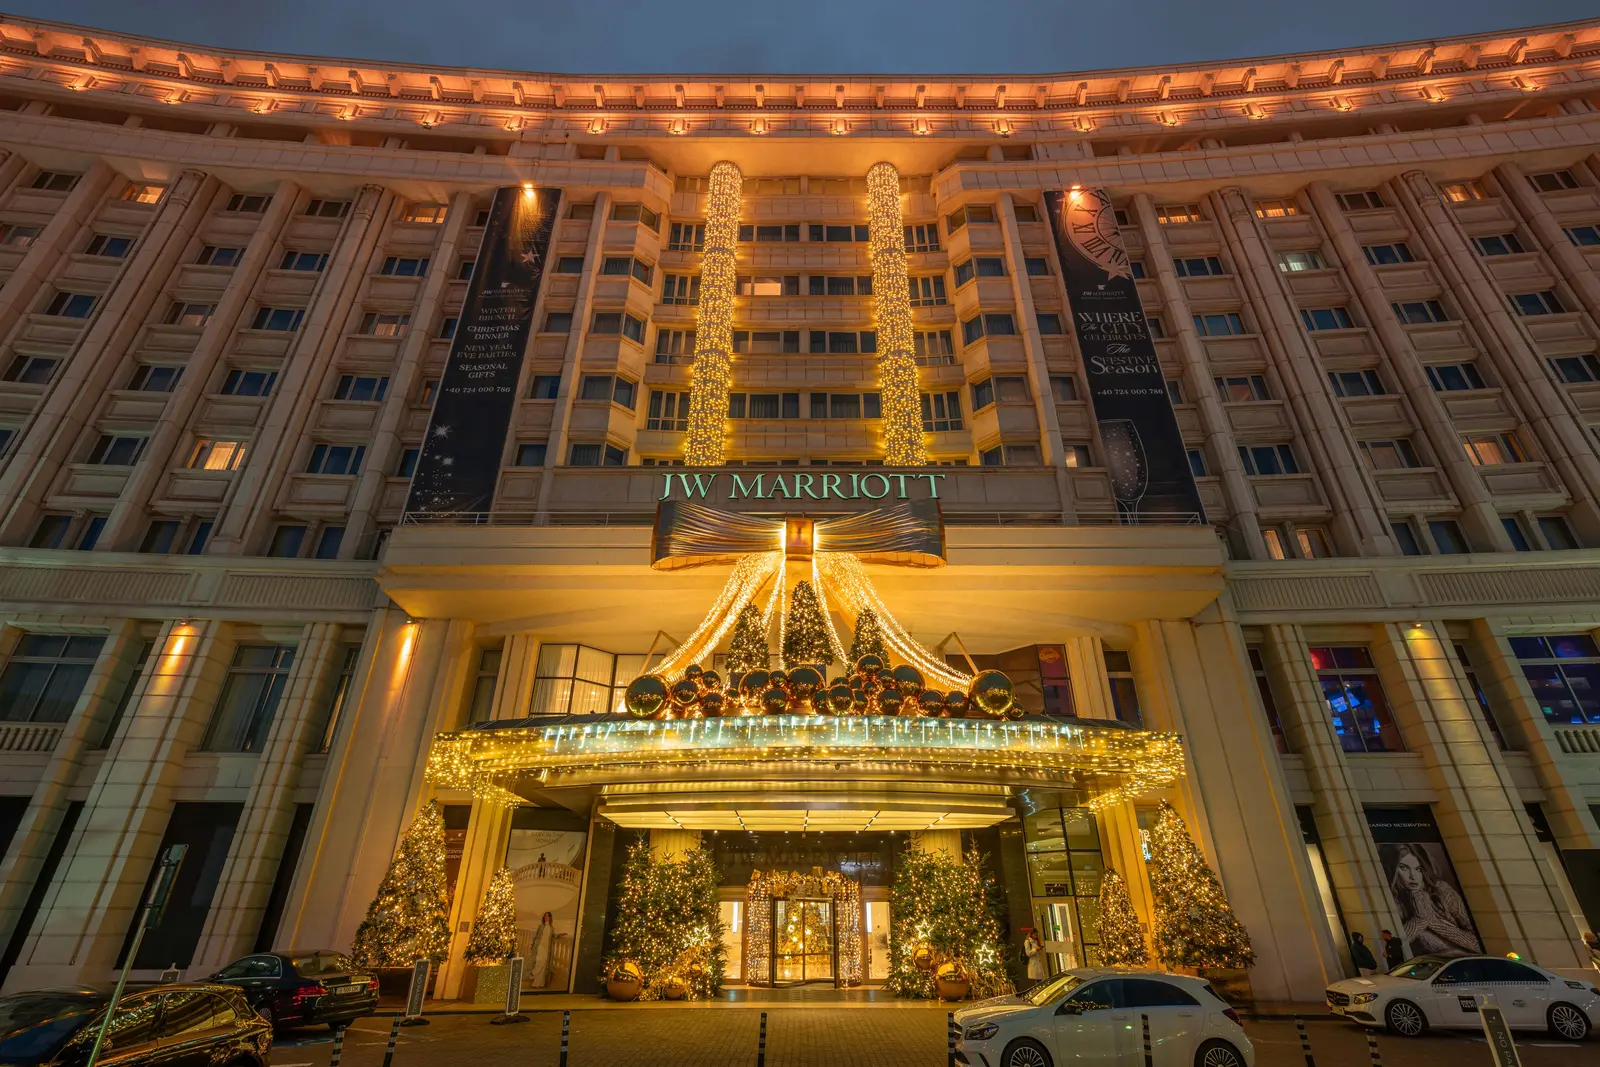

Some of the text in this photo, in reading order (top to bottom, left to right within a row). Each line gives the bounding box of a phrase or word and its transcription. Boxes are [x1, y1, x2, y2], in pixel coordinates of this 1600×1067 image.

[1078, 311, 1143, 323] WHERE
[467, 325, 520, 333] CHRISTMAS
[1100, 322, 1142, 334] CITY
[474, 332, 510, 340] DINNER
[1083, 333, 1147, 341] CELEBRATES
[1106, 343, 1131, 355] The
[456, 351, 517, 359] EVE PARTIES
[1102, 355, 1156, 365] FESTIVE
[1091, 356, 1158, 375] Season
[468, 371, 496, 379] GIFTS
[658, 473, 946, 501] JW MARRIOTT
[1496, 1031, 1515, 1067] NO PA
